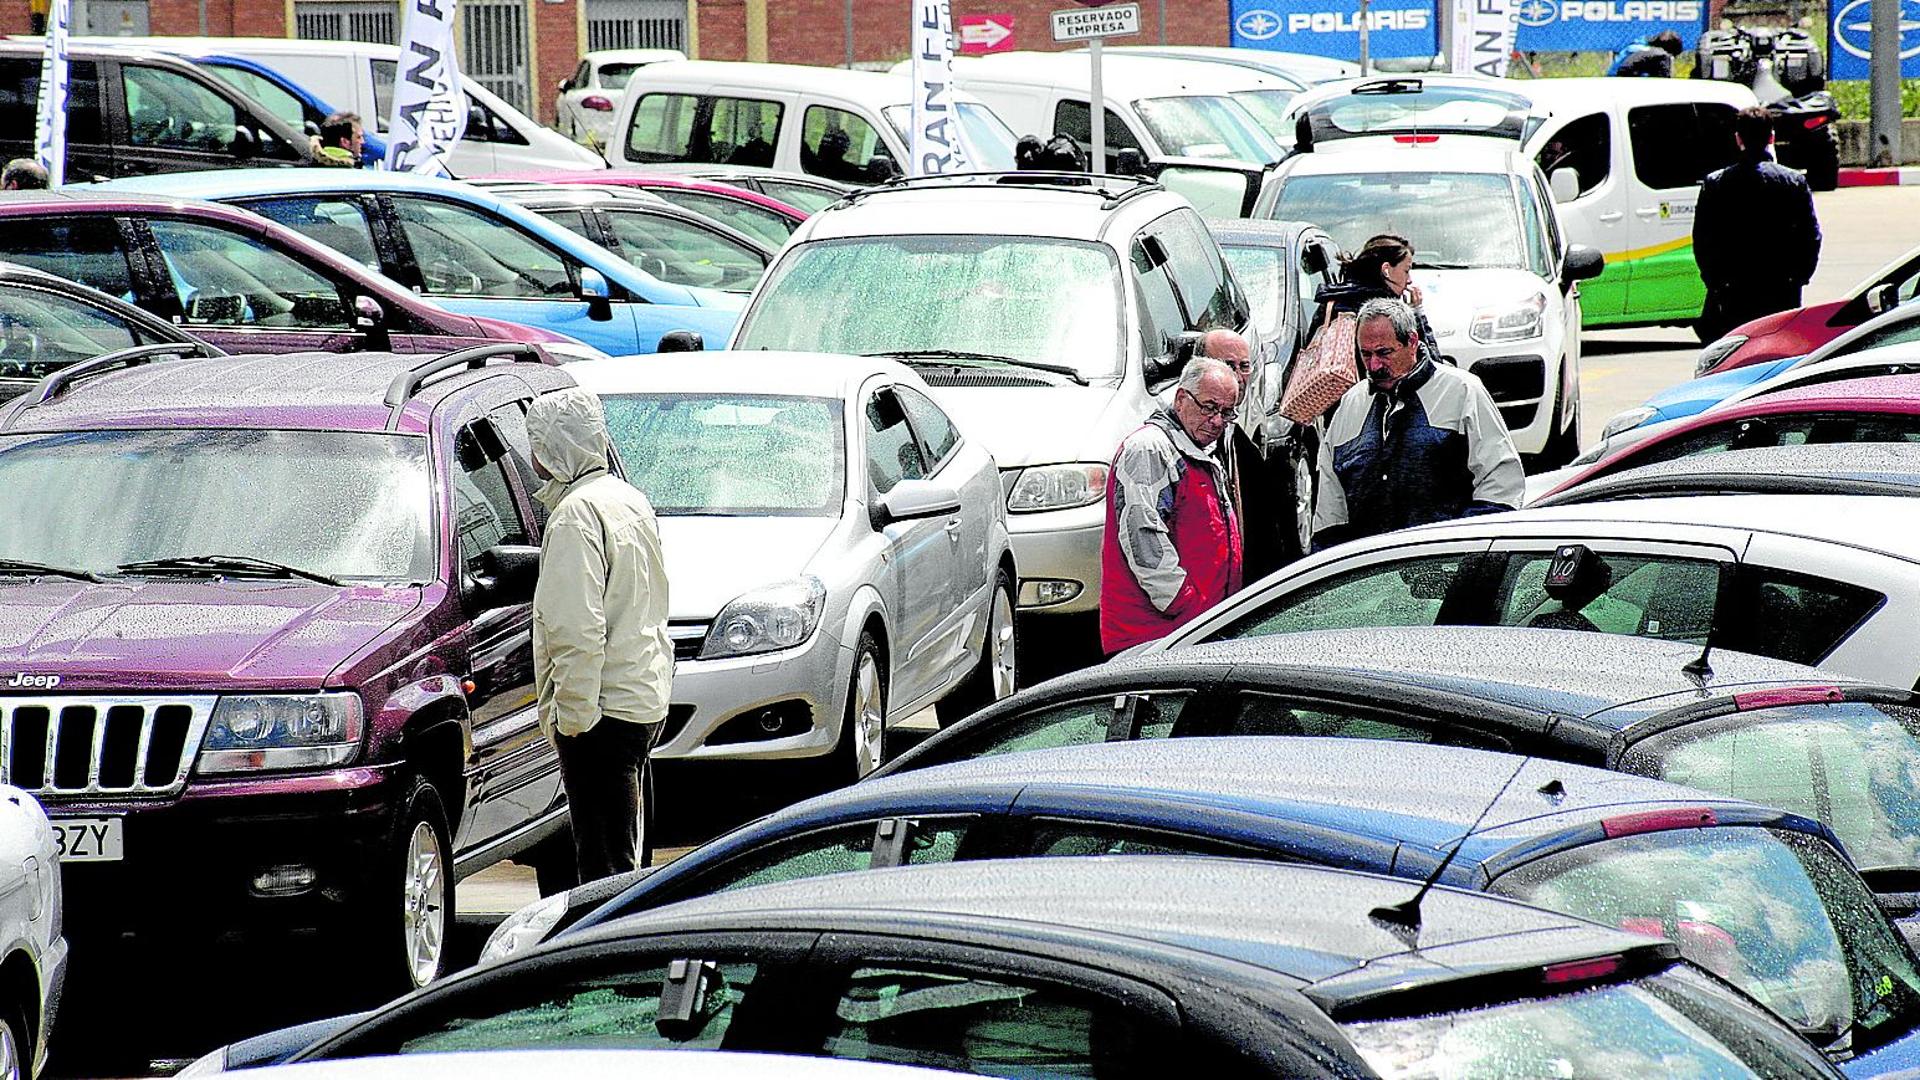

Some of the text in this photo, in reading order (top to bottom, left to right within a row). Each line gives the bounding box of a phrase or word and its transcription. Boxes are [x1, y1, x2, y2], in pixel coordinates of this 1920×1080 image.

[1058, 9, 1132, 26] RESERVADO
[1288, 9, 1429, 34] POLARIS
[1560, 1, 1699, 22] POLARIS
[1067, 22, 1125, 36] EMPRESA
[1474, 31, 1502, 78] AN
[922, 81, 952, 175] RAN
[9, 672, 61, 690] Jeep
